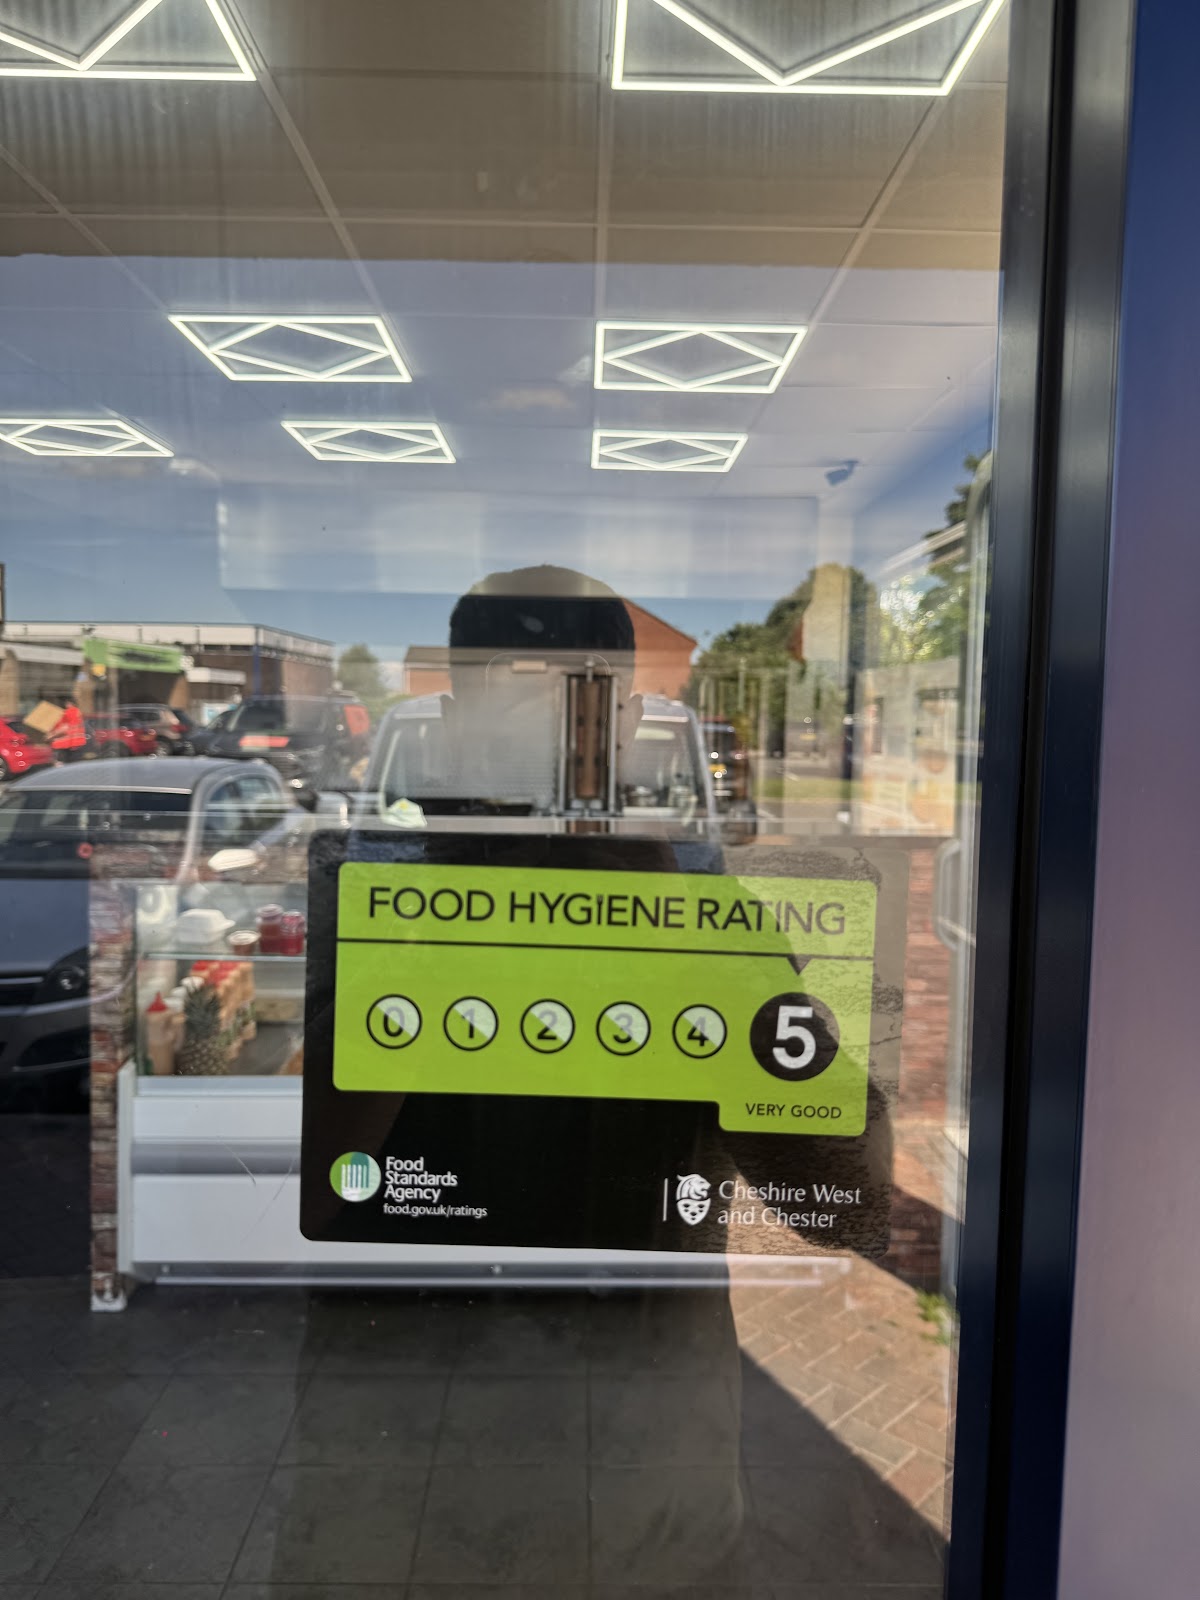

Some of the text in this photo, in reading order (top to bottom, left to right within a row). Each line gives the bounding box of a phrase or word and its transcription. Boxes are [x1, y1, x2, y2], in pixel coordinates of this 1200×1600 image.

[369, 886, 846, 935] FOOD HYGIENE RATING
[383, 1005, 817, 1070] 0 1 2 3 4 5
[745, 1103, 842, 1119] VERY GOOD
[385, 1156, 424, 1171] Food
[385, 1170, 458, 1186] Standards
[384, 1184, 441, 1203] Agency
[718, 1180, 862, 1204] Cheshire West
[383, 1203, 488, 1219] food.gov.uk/ratings
[717, 1206, 837, 1228] and Chester
